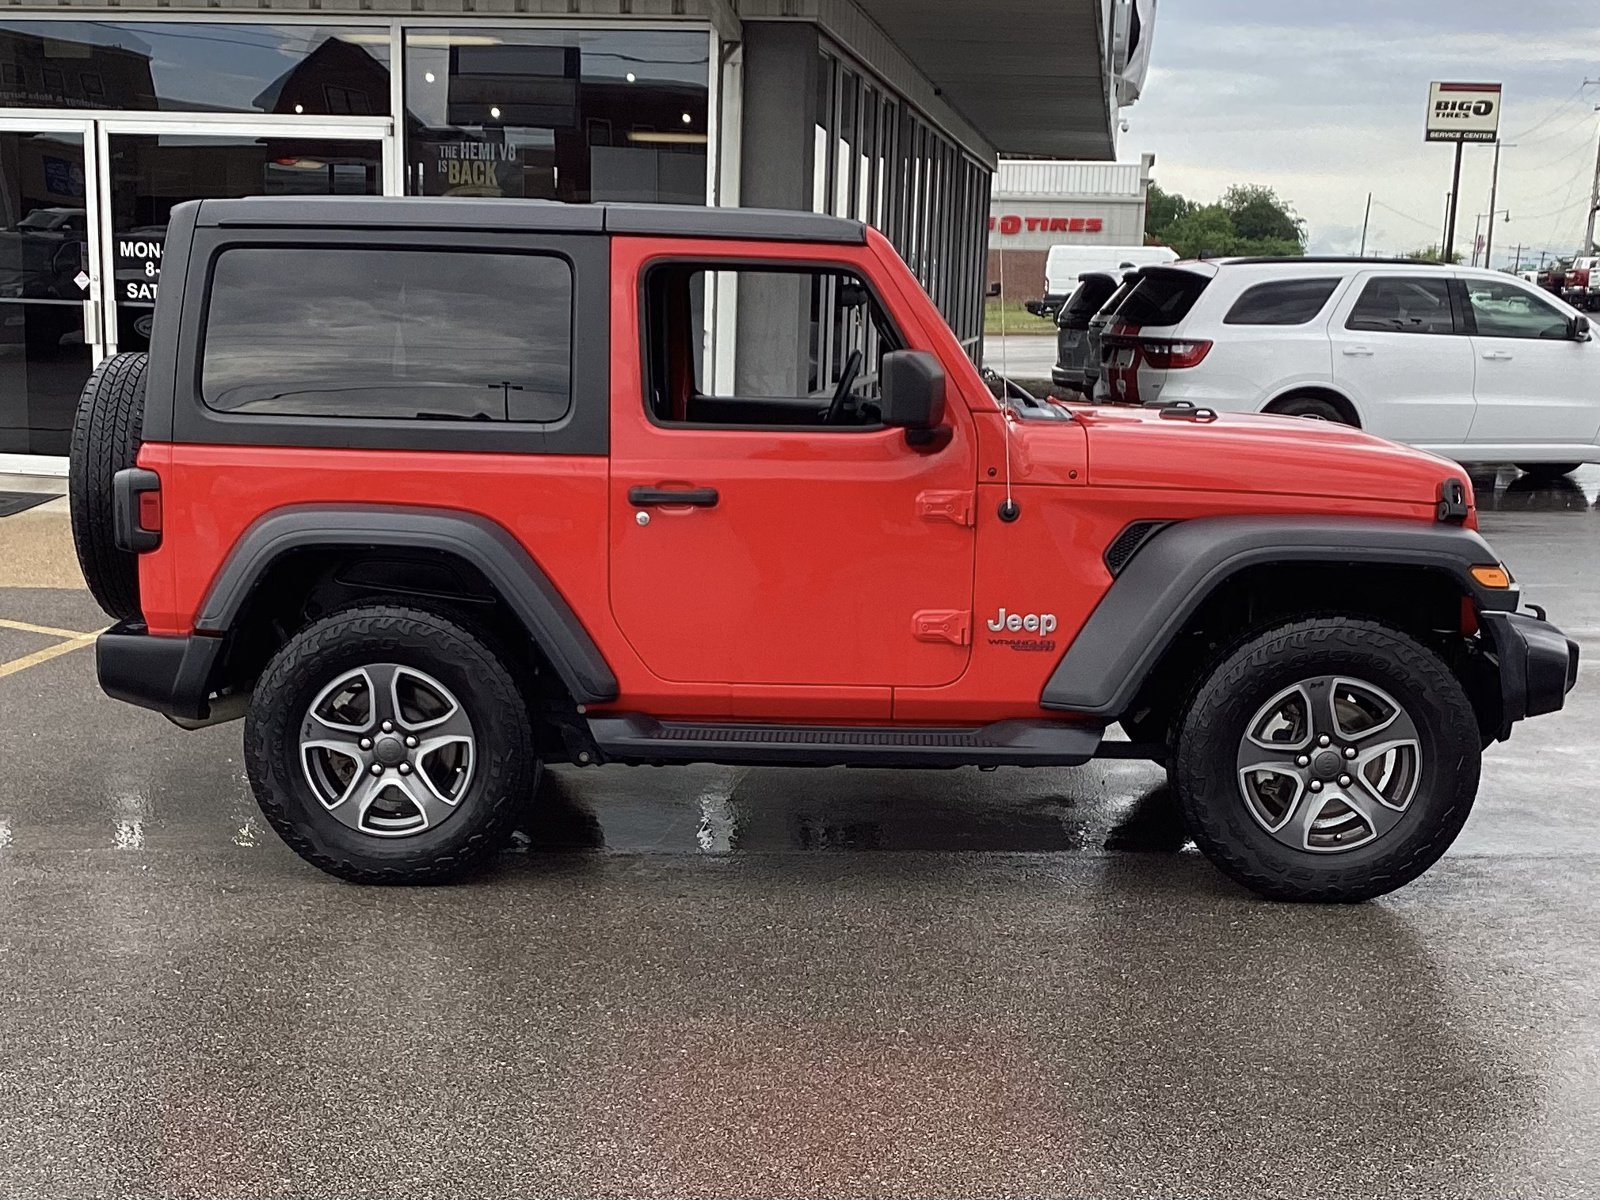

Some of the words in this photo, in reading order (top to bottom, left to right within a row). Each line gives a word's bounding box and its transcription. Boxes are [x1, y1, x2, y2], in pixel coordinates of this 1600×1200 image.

[439, 145, 458, 159] THE
[460, 142, 496, 160] HEMI
[499, 143, 517, 161] V8
[438, 160, 448, 173] IS
[448, 160, 498, 186] BACK
[1025, 217, 1103, 232] TIRES
[126, 283, 158, 299] SAT
[987, 608, 1057, 637] Jeep
